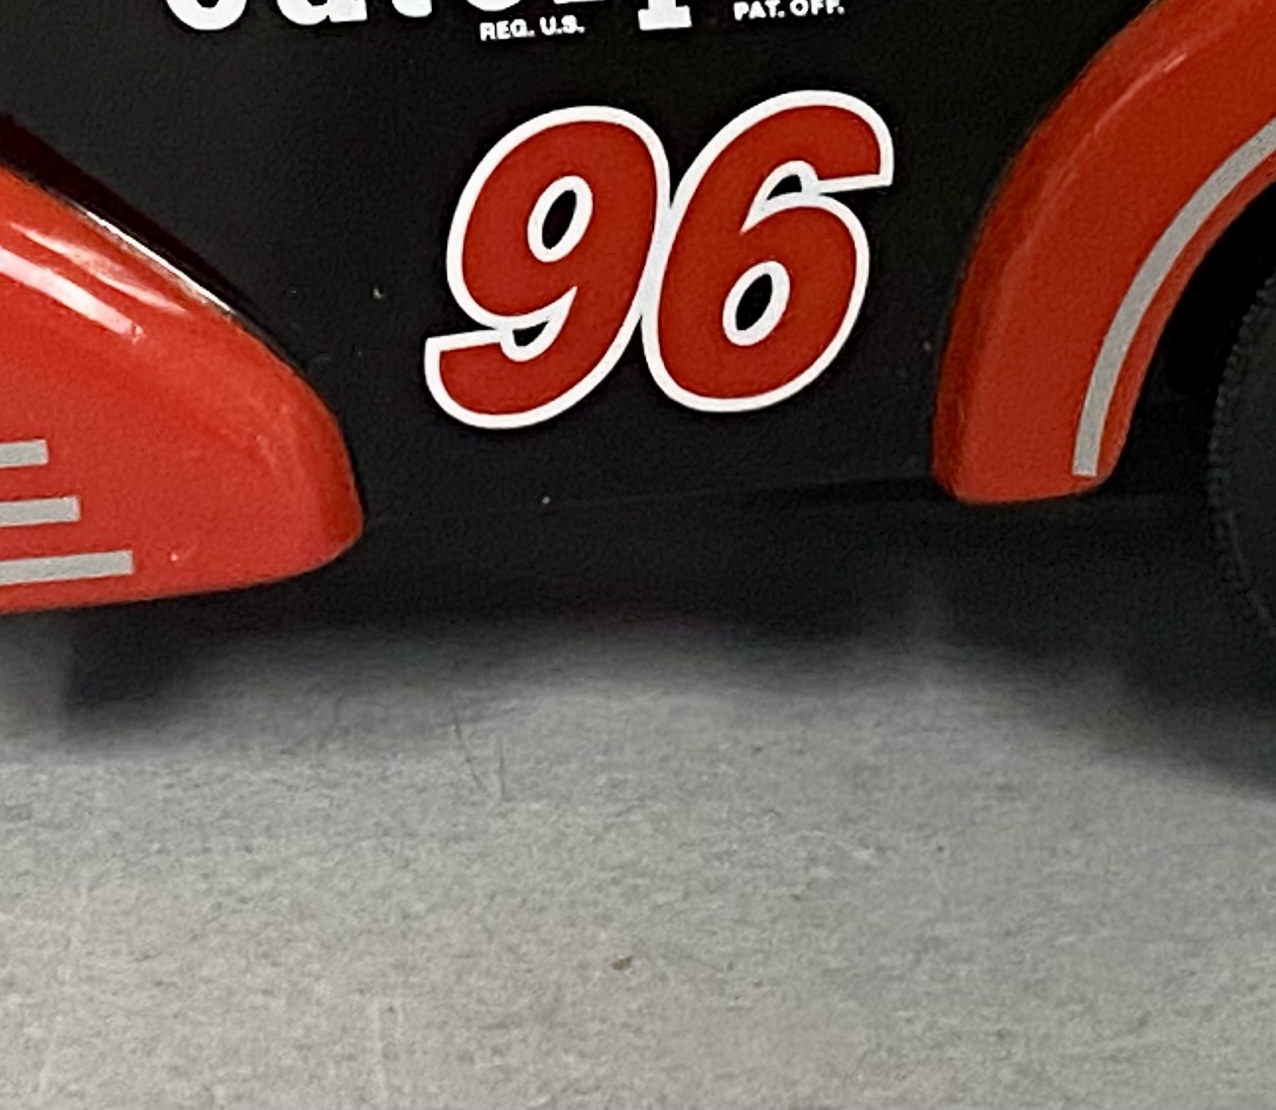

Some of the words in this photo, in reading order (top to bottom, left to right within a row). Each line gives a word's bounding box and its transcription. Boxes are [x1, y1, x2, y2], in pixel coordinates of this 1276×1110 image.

[733, 0, 786, 21] PAT.
[540, 14, 586, 36] U.S.
[425, 90, 894, 429] 96
